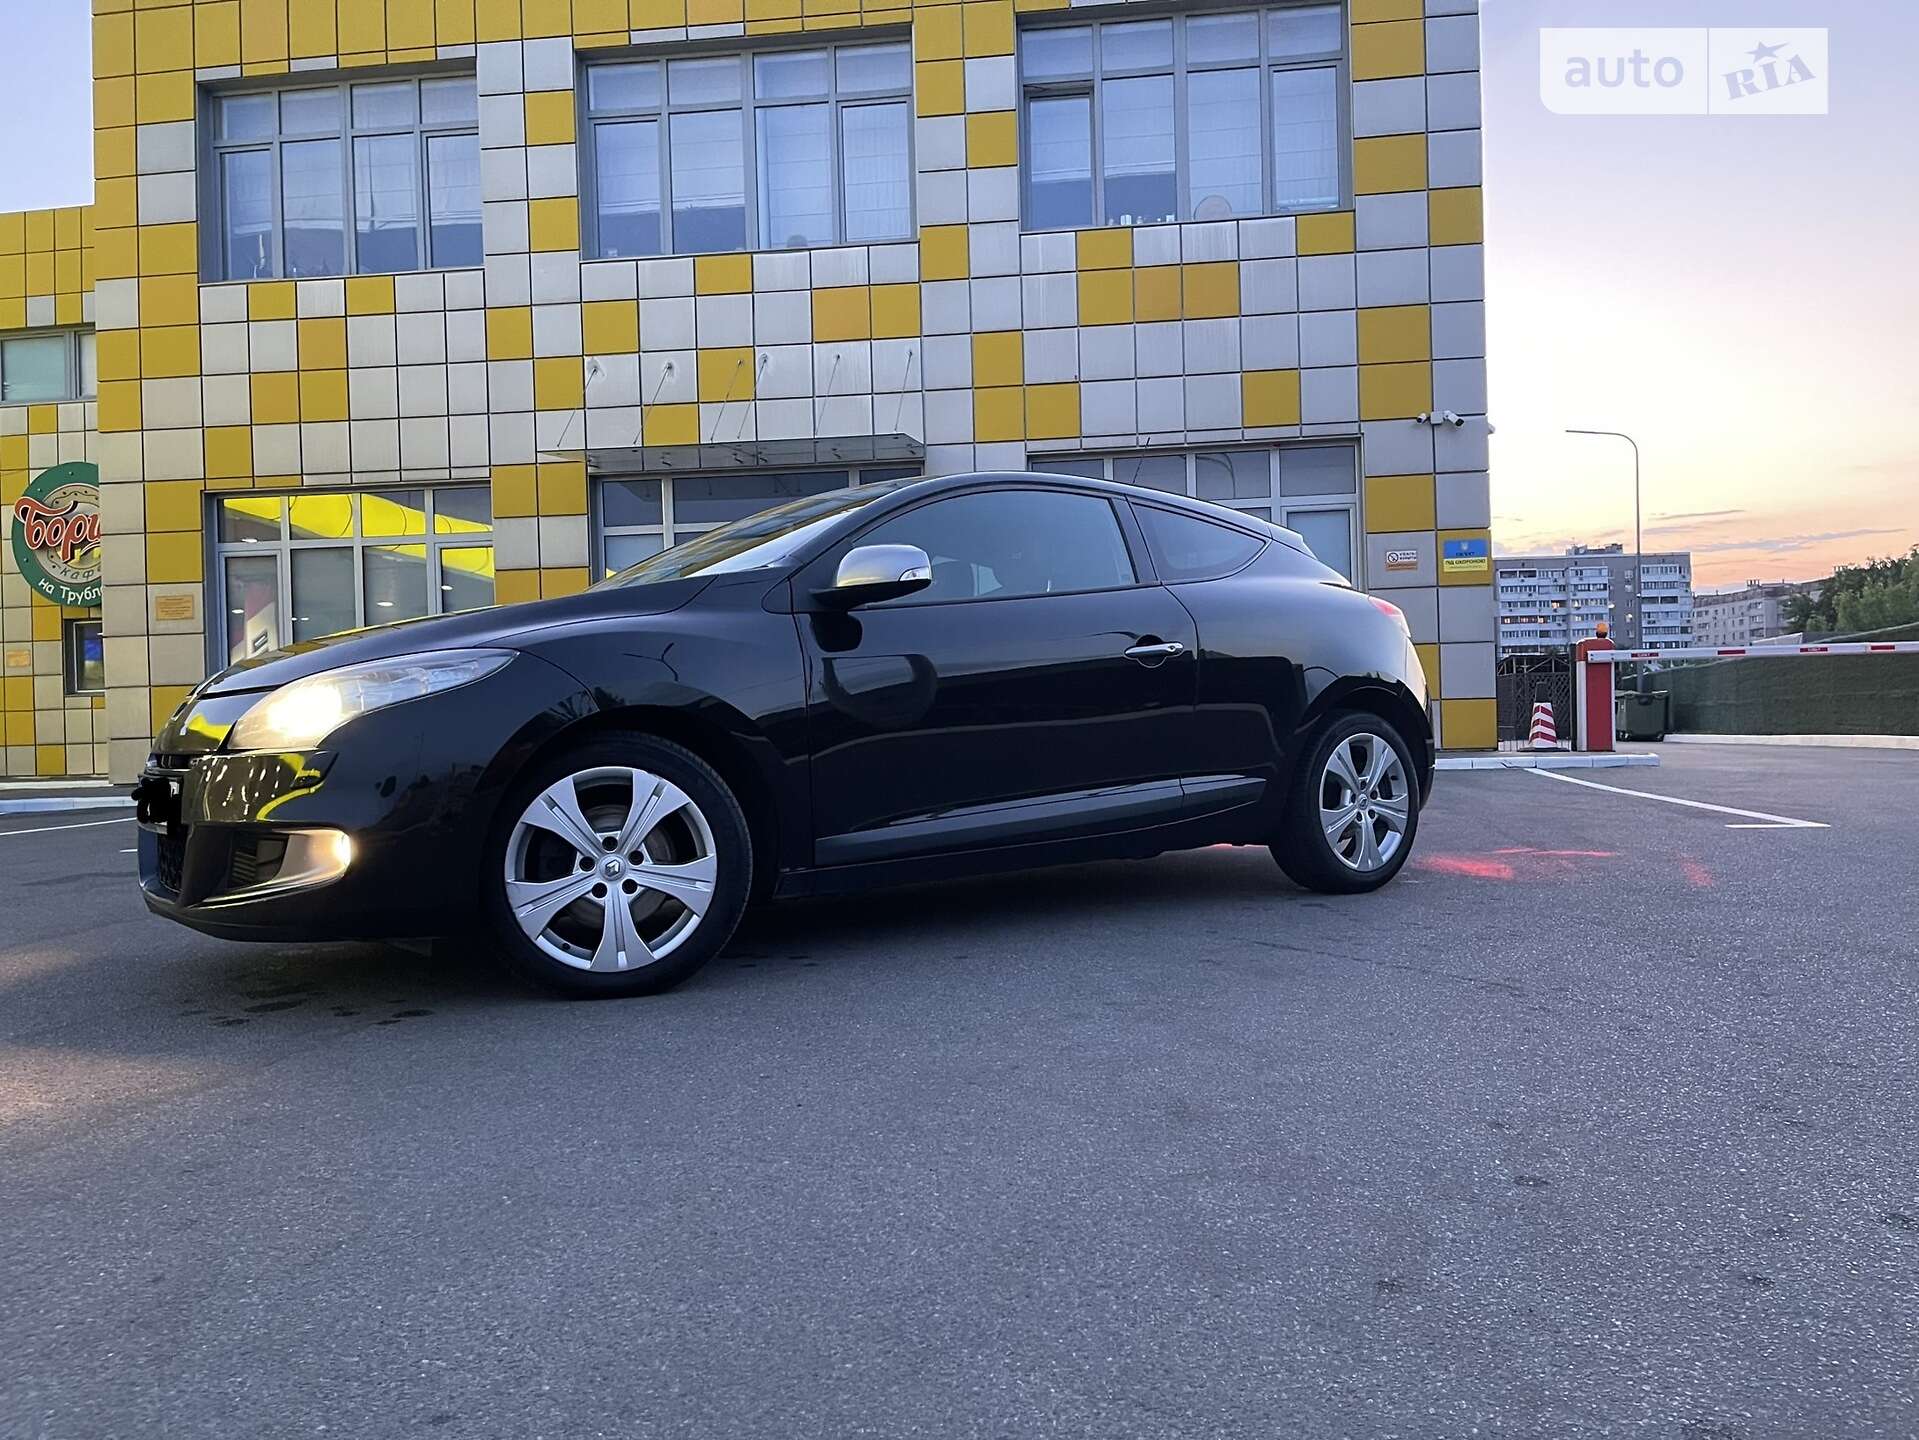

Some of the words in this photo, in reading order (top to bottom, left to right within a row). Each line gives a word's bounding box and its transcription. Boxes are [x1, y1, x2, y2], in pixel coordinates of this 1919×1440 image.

[60, 566, 101, 581] каф
[38, 578, 55, 594] на
[60, 585, 102, 605] Трубл
